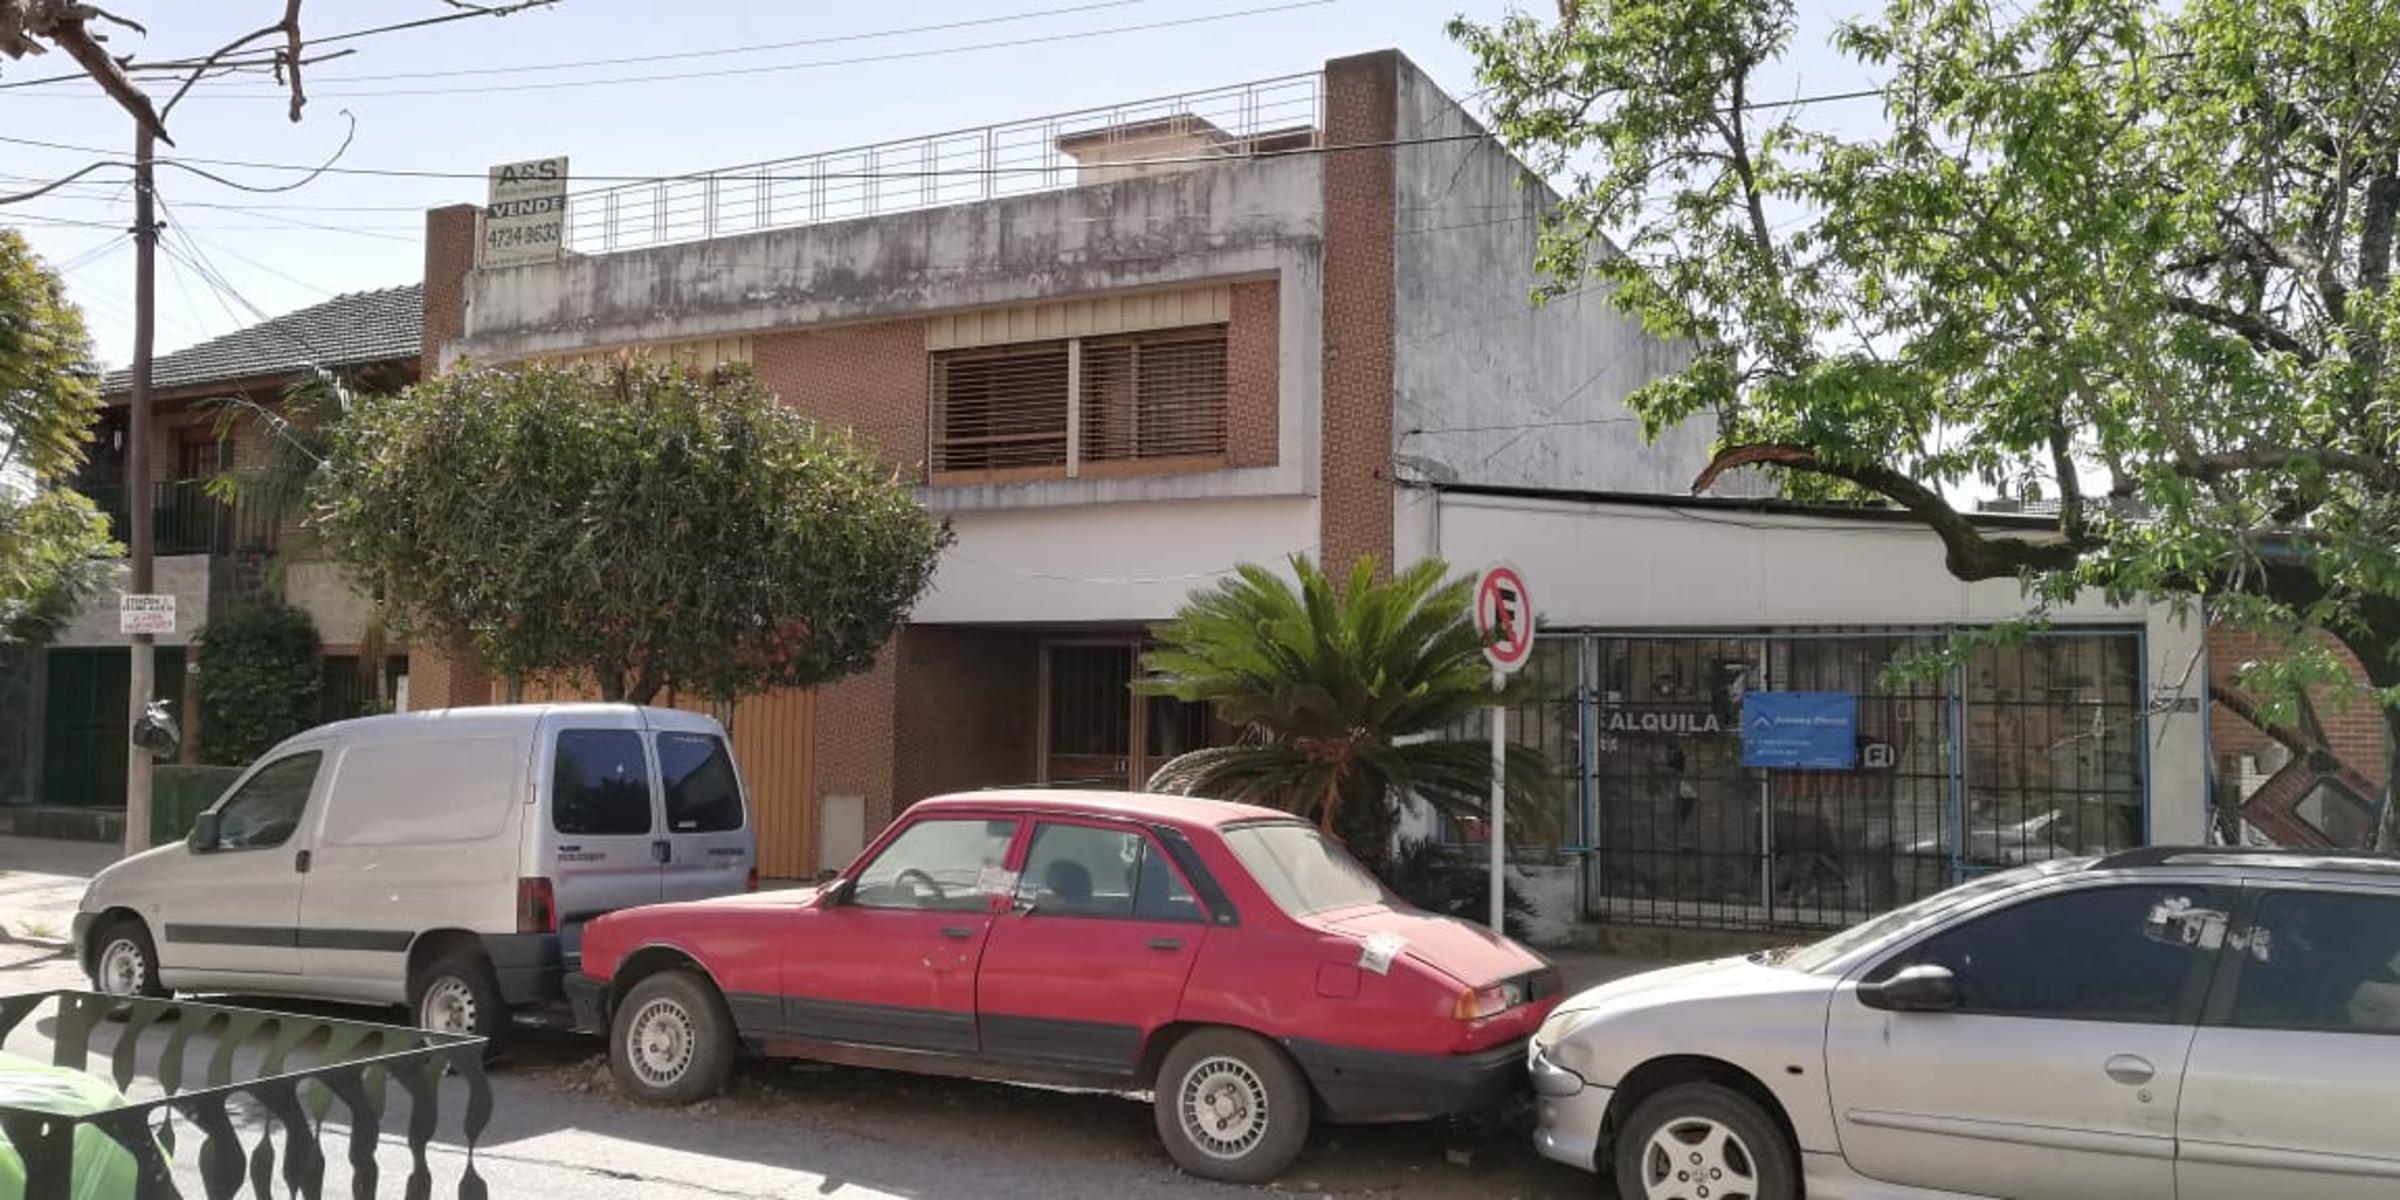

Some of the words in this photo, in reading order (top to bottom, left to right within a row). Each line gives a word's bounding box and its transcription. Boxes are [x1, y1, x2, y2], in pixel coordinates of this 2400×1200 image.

[499, 161, 558, 186] A&S
[493, 197, 563, 217] VENDE
[1608, 711, 1720, 734] ALQUILA
